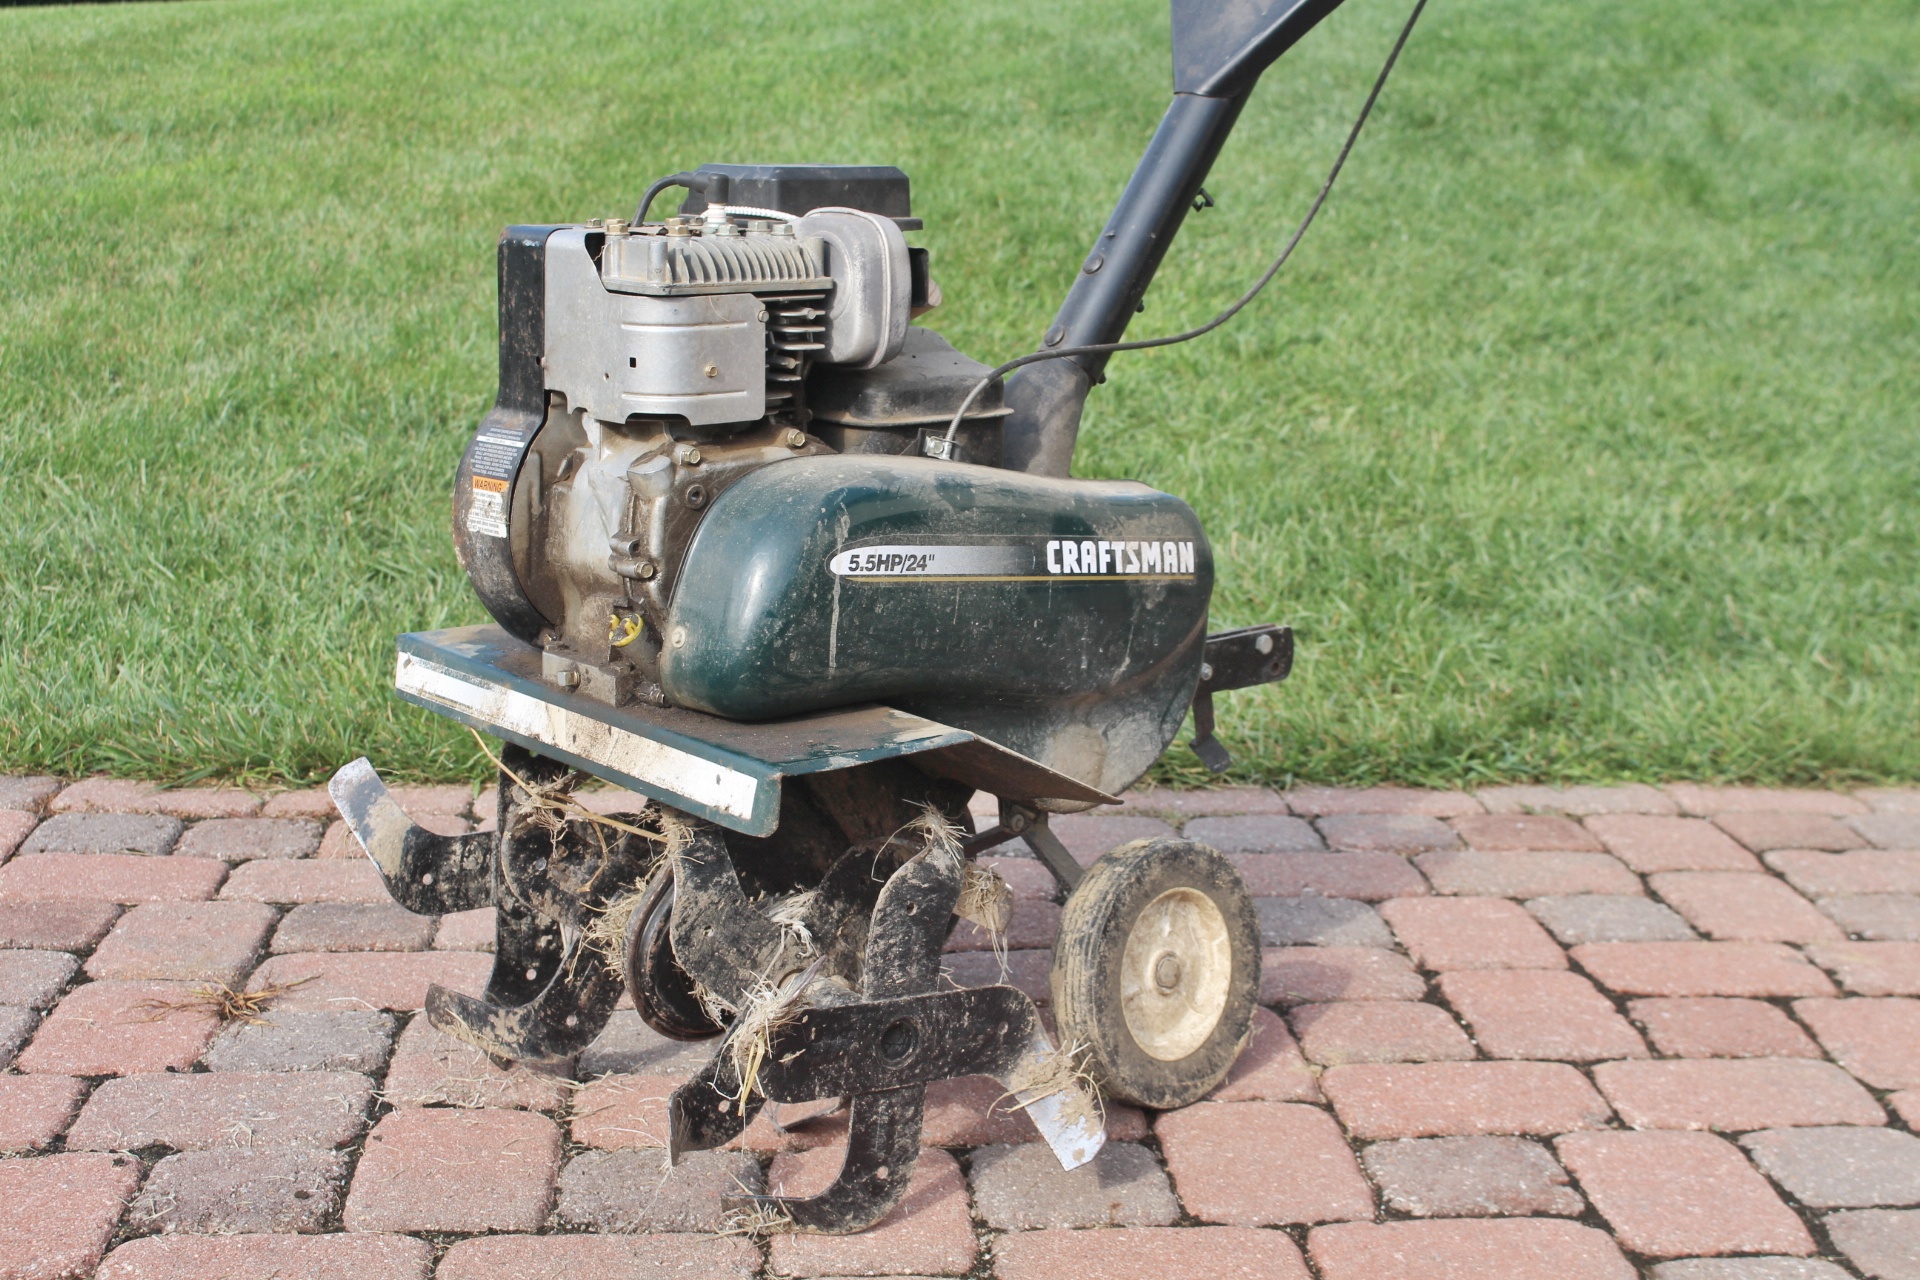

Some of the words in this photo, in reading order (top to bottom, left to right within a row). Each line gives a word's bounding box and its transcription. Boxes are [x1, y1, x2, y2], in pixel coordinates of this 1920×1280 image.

[474, 479, 502, 493] WARNING
[848, 554, 935, 573] 5.5HP/24"
[1046, 540, 1195, 573] CRAFTSMAN
